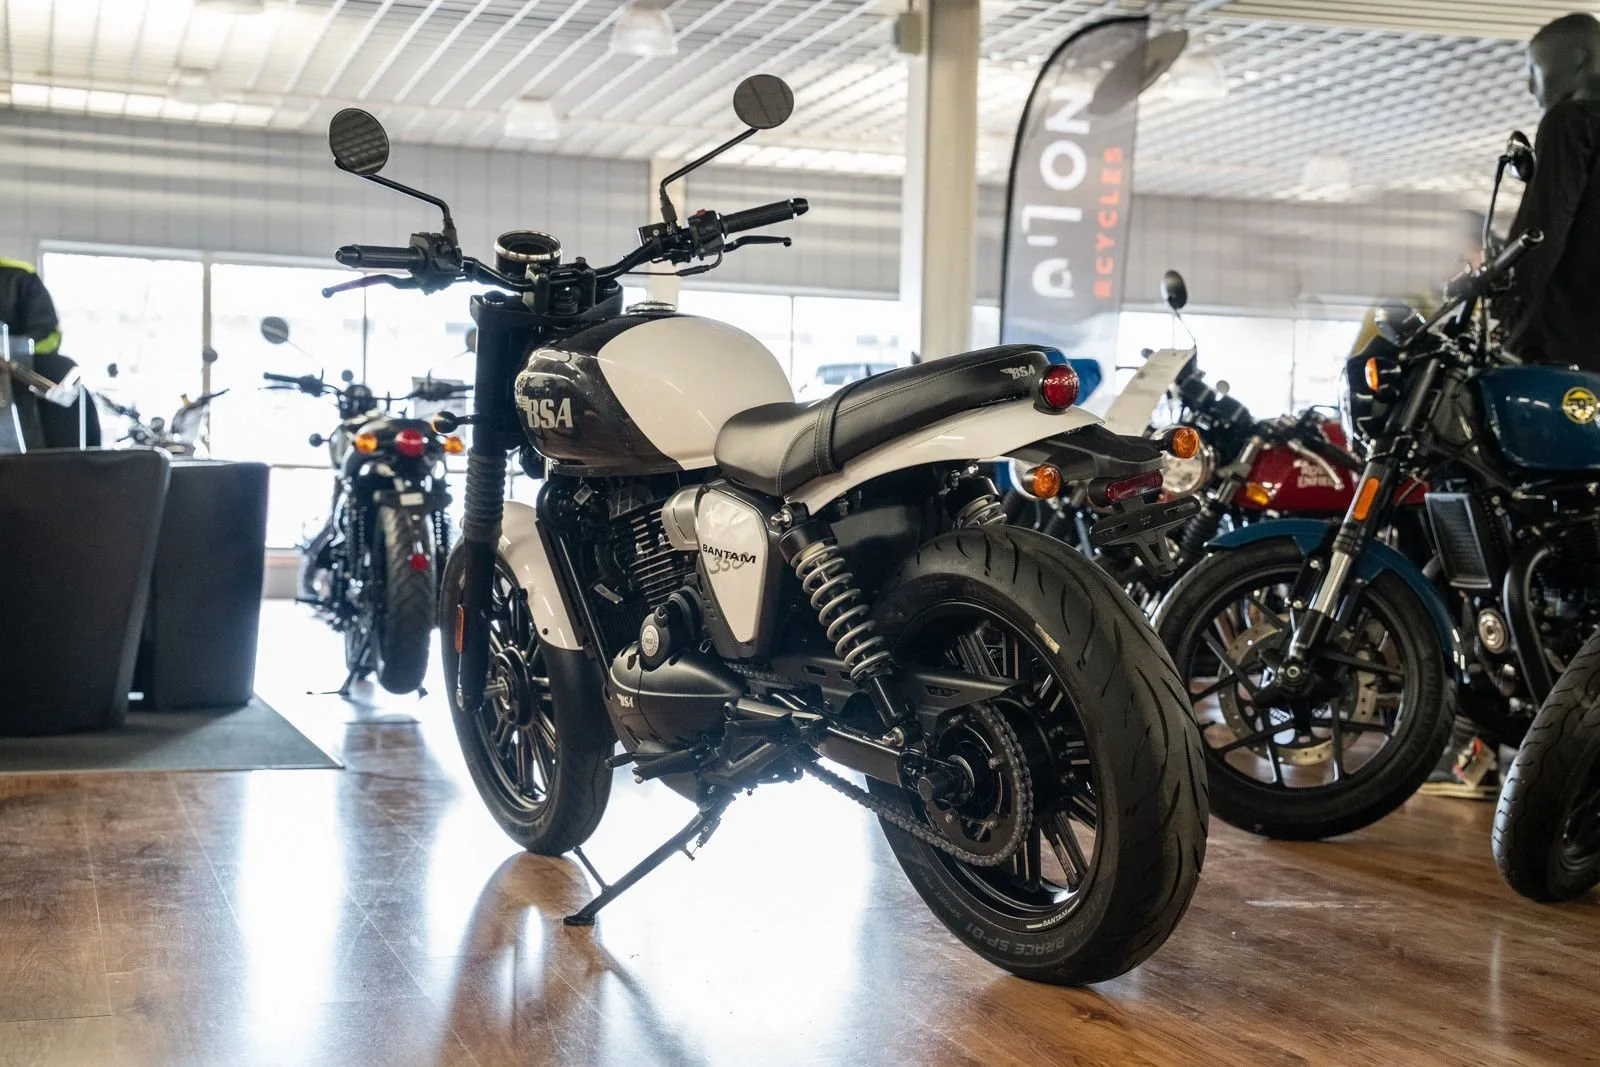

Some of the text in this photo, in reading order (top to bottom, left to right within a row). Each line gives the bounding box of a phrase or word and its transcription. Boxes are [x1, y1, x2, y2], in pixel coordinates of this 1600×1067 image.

[1012, 364, 1036, 380] BSA
[526, 397, 574, 429] BSA
[702, 543, 757, 564] BANTAM
[708, 551, 749, 575] 350
[1042, 908, 1068, 927] BANTAM
[1016, 938, 1065, 956] BRACE
